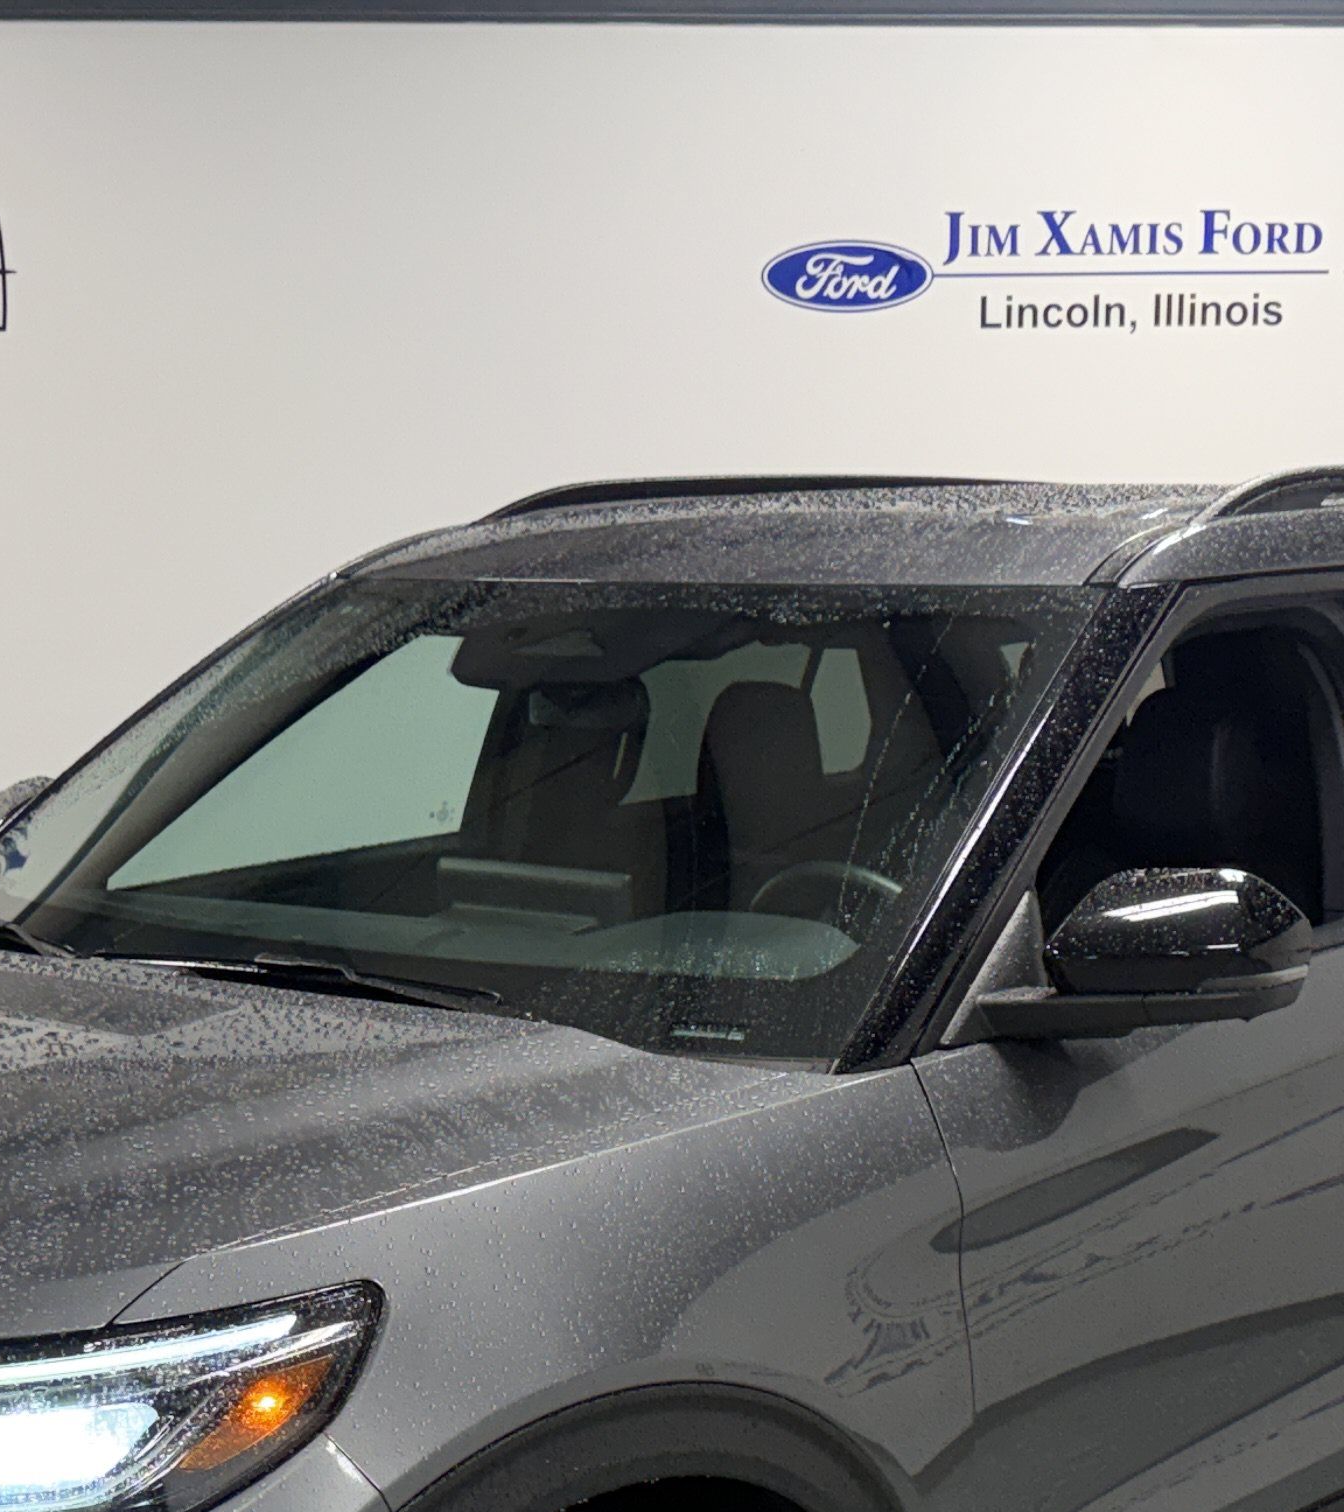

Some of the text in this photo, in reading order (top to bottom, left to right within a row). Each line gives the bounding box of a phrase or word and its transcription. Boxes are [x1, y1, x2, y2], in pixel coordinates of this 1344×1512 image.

[942, 209, 1324, 267] JIM XAMIS FORD
[795, 252, 897, 301] Ford
[979, 292, 1284, 335] Lincoln, Illinois
